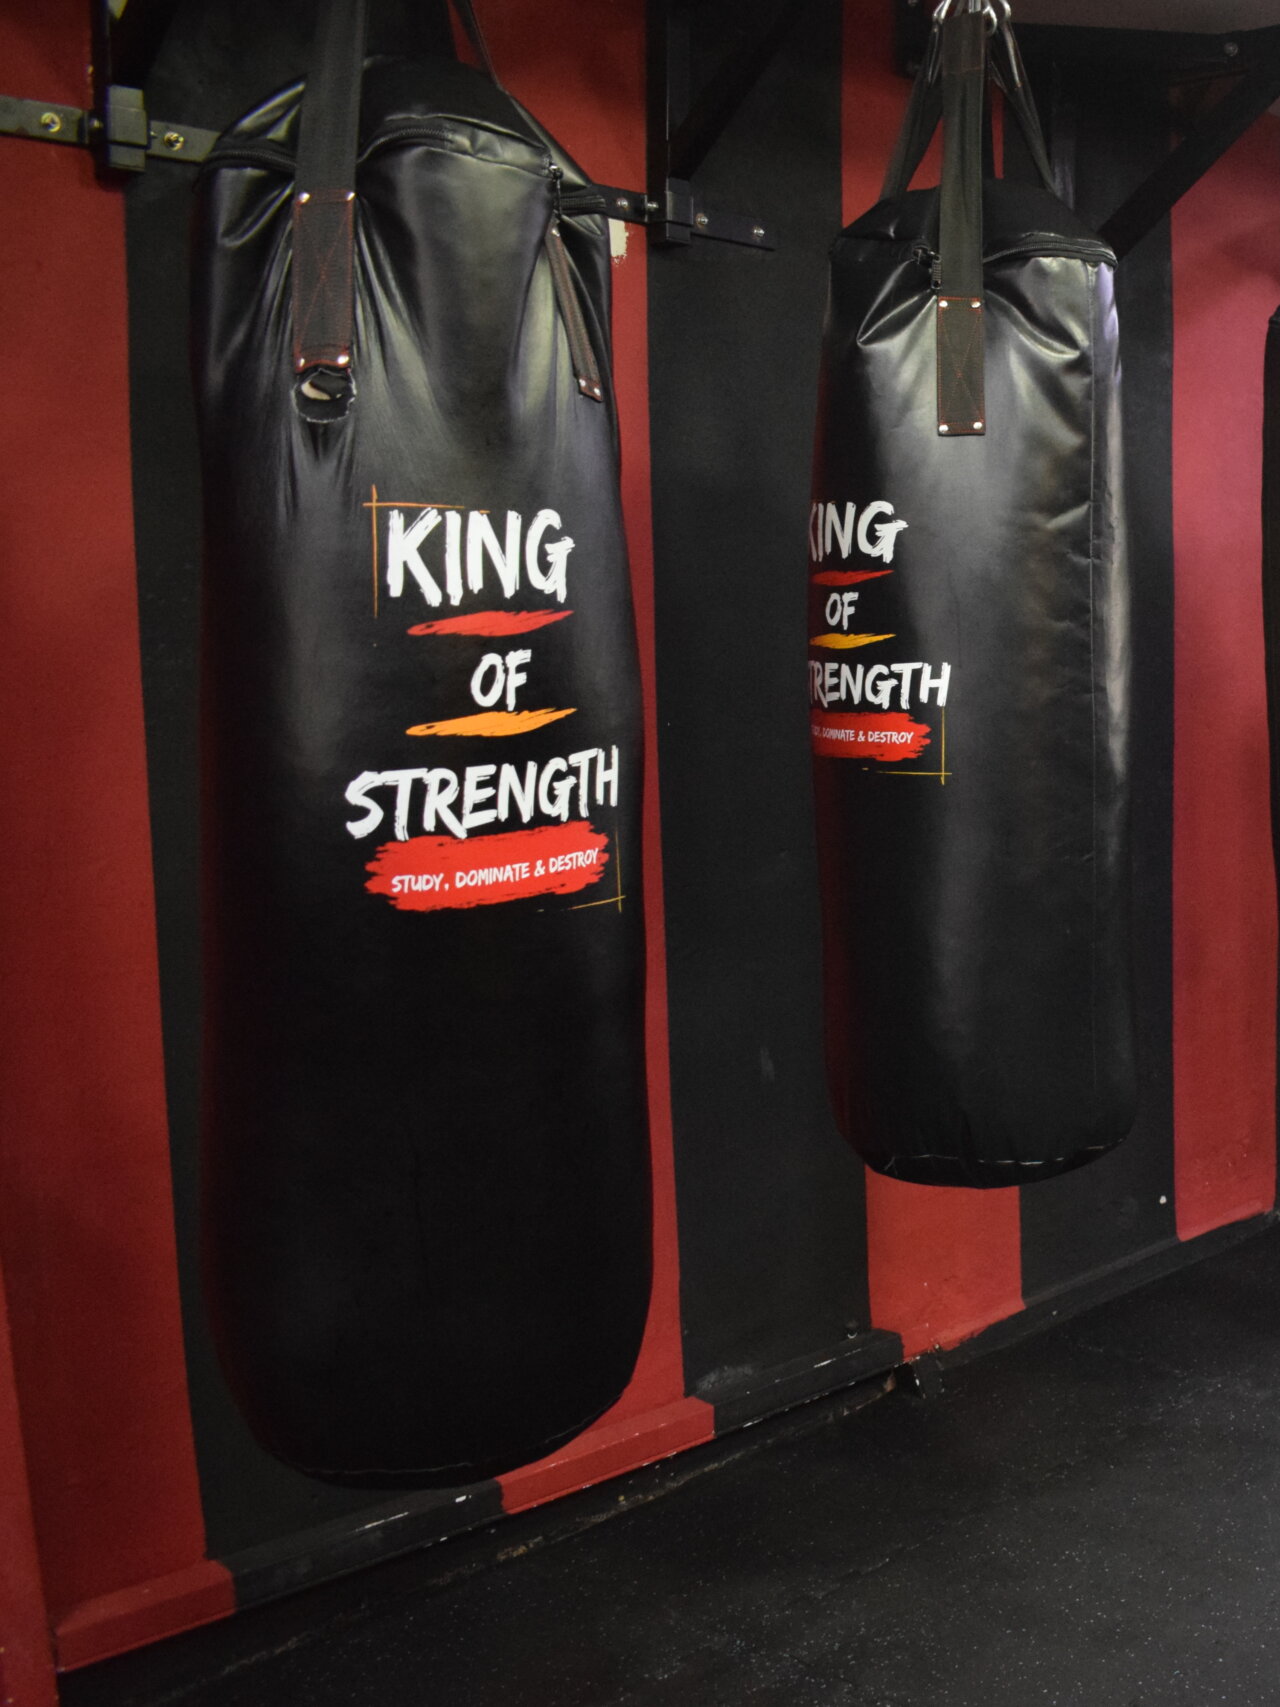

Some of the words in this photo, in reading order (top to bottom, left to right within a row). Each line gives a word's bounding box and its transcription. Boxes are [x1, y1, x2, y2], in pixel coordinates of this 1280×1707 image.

[386, 507, 575, 607] KING
[825, 592, 859, 630] OF
[470, 649, 532, 711] OF
[857, 731, 865, 742] &
[868, 731, 914, 744] DESTROY
[345, 745, 619, 841] STRENGTH
[455, 862, 530, 888] DOMINATE
[534, 860, 545, 877] &
[549, 848, 599, 873] DESTROY
